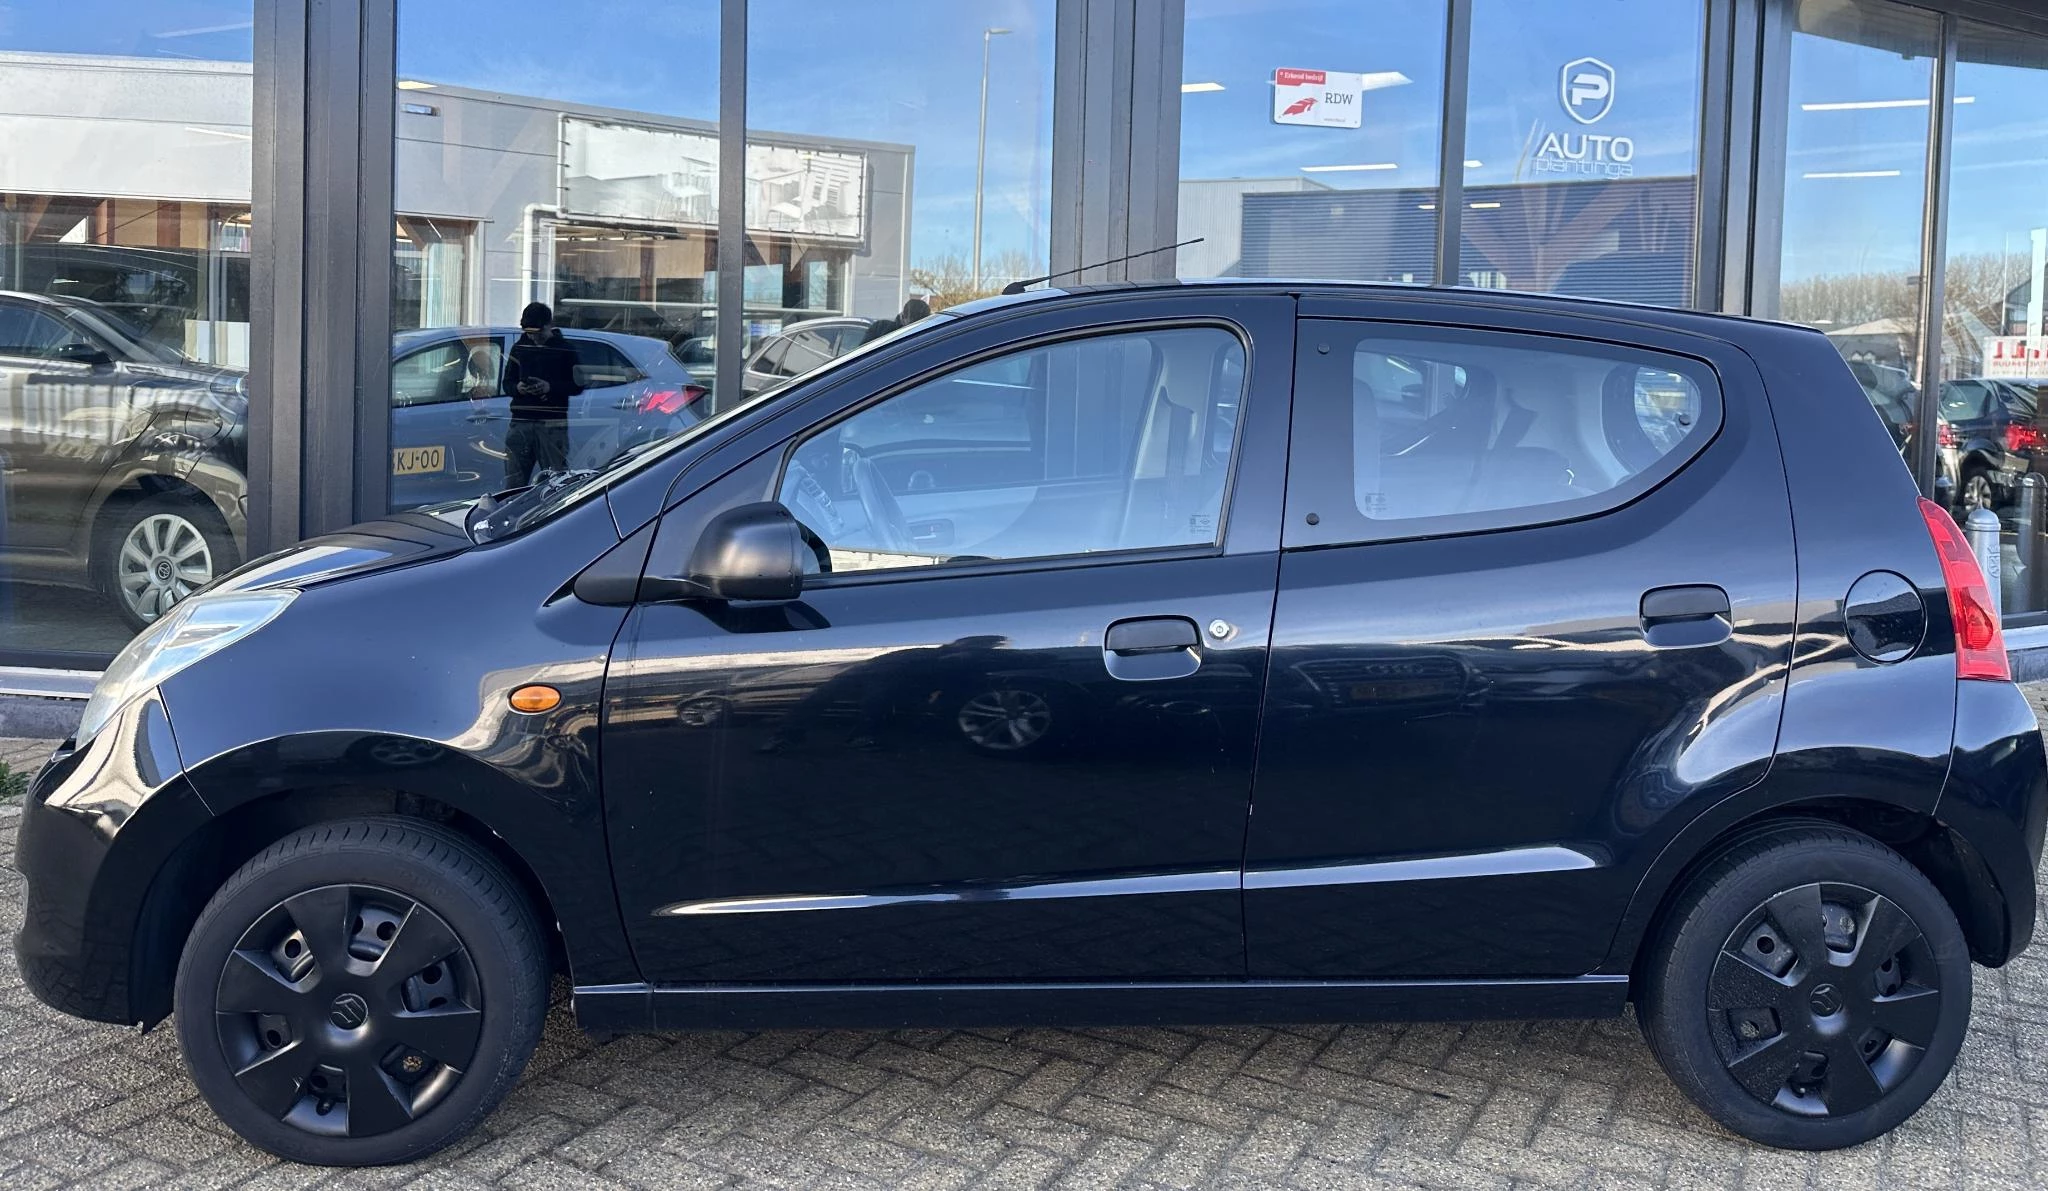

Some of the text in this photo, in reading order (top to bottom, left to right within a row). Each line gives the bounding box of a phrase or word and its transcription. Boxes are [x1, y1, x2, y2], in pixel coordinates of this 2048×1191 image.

[1325, 92, 1353, 105] RDW
[1537, 132, 1634, 162] AUTO
[1535, 156, 1634, 180] plantinga
[392, 450, 440, 471] KJ-00
